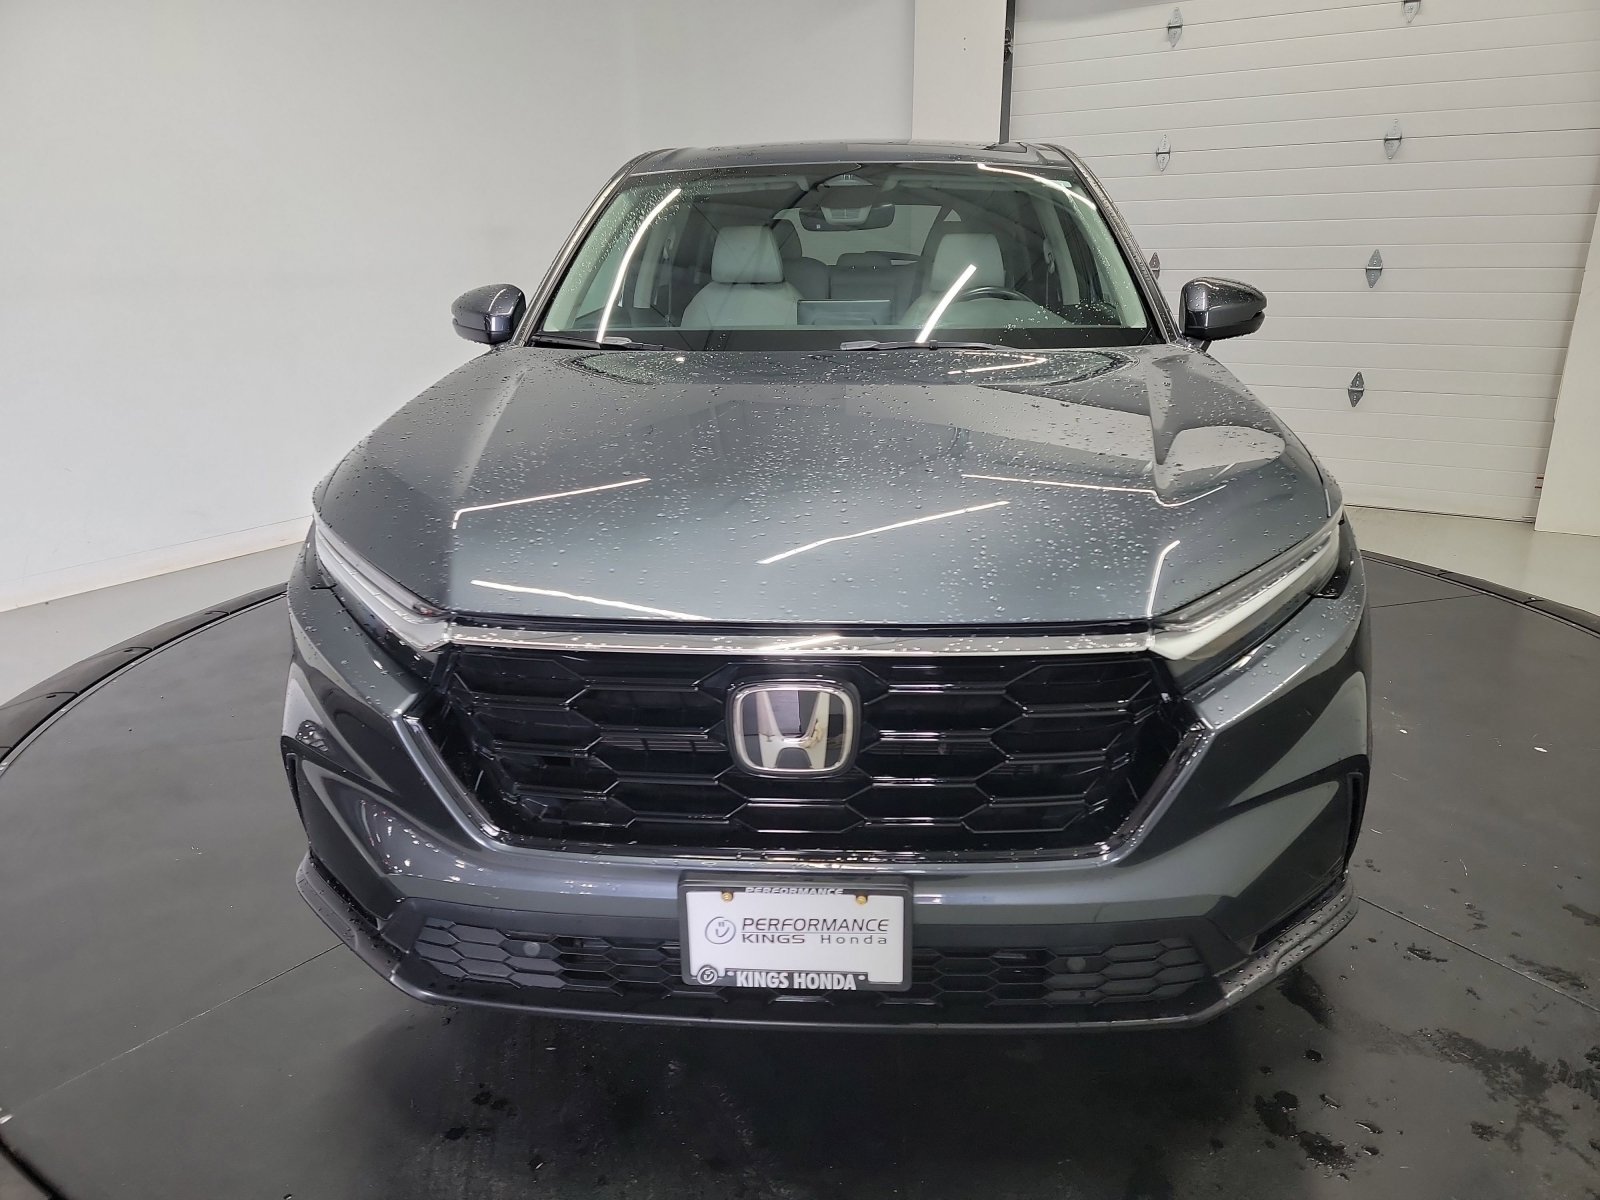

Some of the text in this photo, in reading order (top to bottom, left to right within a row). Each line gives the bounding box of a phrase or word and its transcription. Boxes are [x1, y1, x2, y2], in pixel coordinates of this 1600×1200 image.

[745, 887, 844, 896] PERFORMANCE
[742, 917, 889, 932] PERFORMANCE
[742, 934, 888, 945] KINGS Honda
[736, 971, 857, 991] KINGS HONDA
